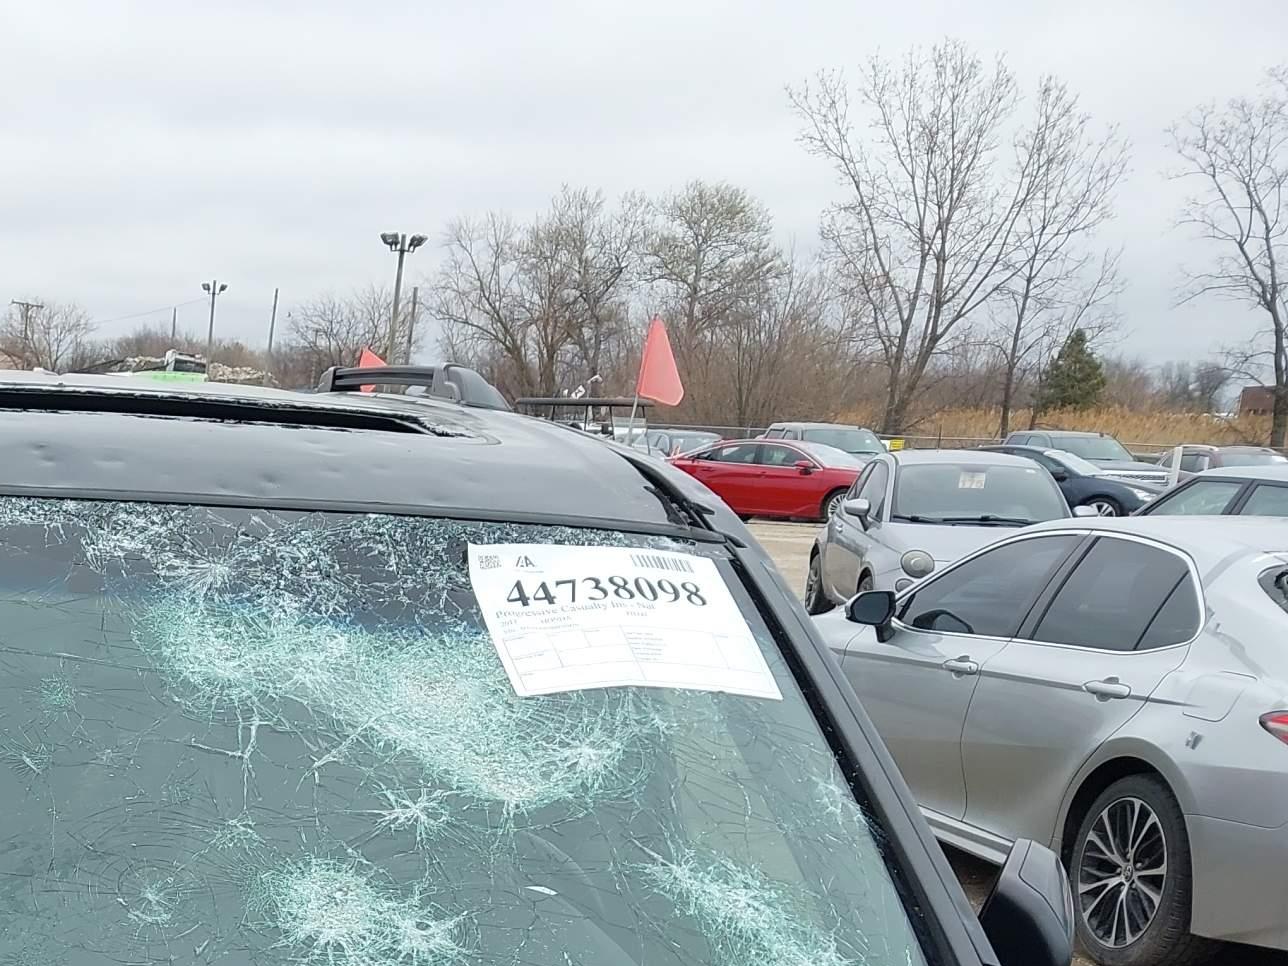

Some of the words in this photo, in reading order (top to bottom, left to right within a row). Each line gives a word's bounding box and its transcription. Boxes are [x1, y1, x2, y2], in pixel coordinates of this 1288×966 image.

[506, 576, 707, 607] 44738098
[496, 608, 558, 619] Progressive
[560, 602, 608, 614] Casualty
